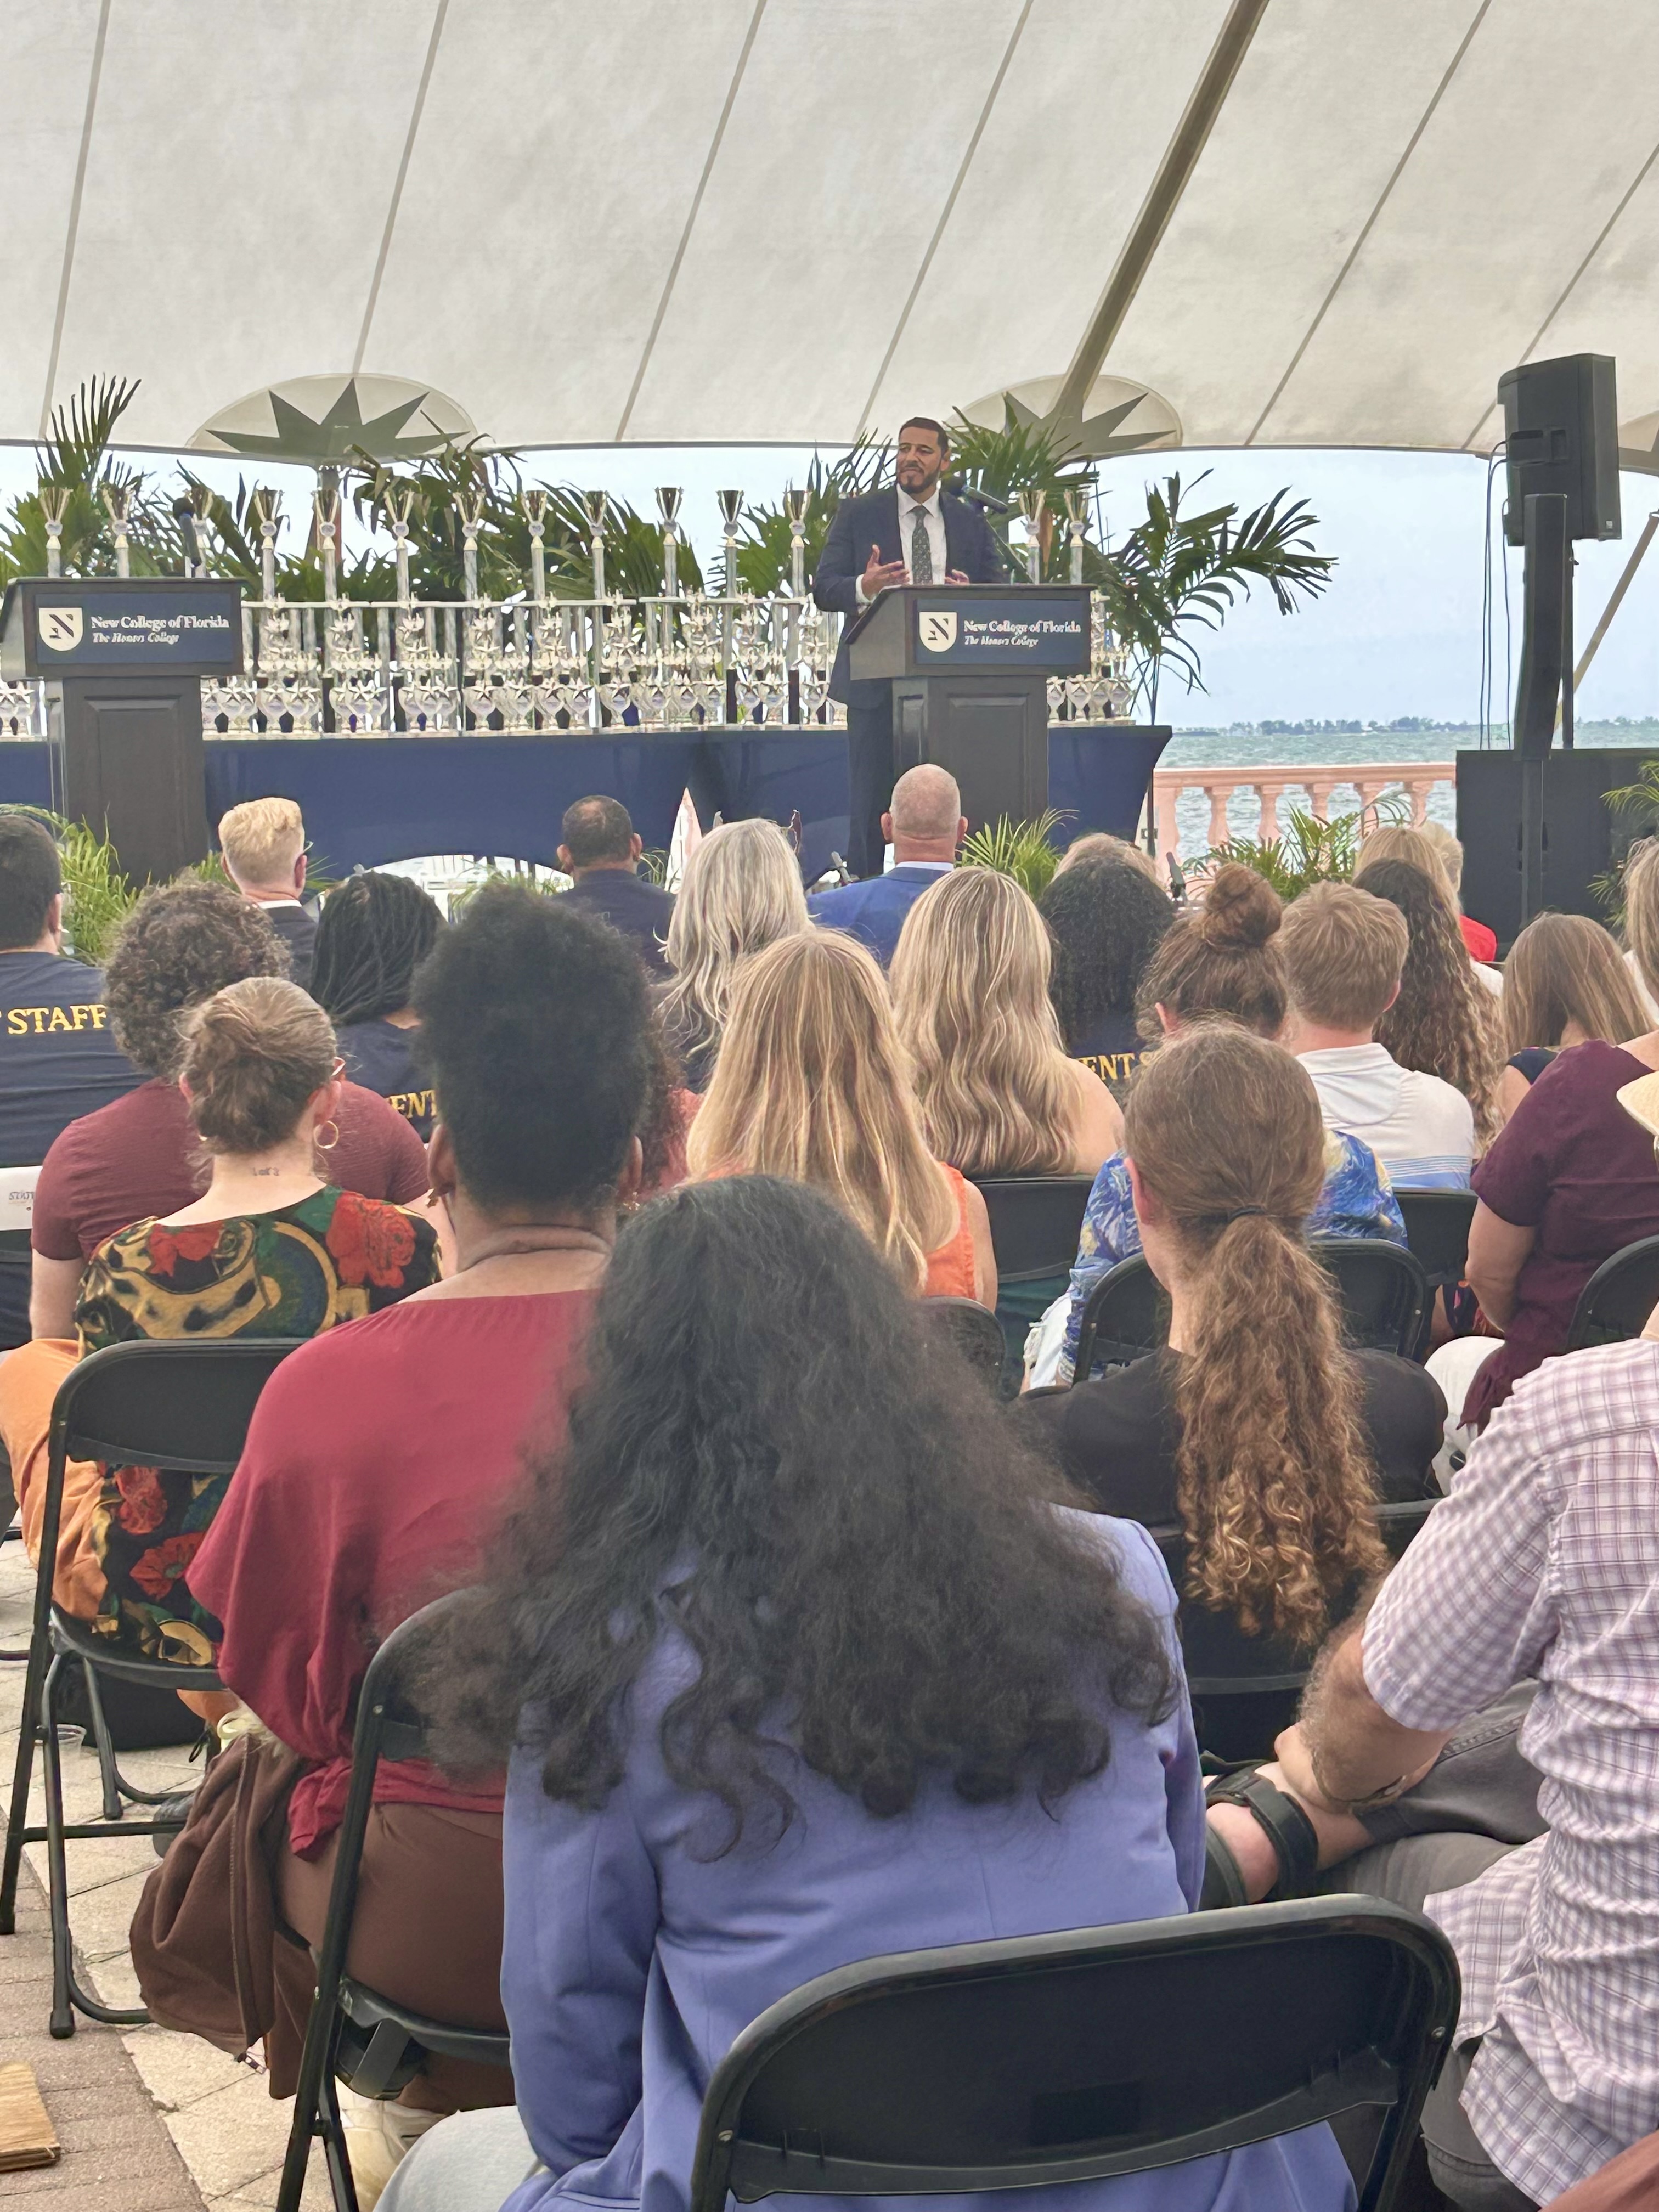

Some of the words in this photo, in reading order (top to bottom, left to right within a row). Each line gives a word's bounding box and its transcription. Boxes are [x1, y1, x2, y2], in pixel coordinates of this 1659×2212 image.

[91, 616, 119, 629] New
[121, 615, 166, 631] College
[168, 615, 184, 628] of
[184, 615, 229, 628] Florida
[963, 620, 986, 632] New
[989, 620, 1027, 636] College
[1029, 620, 1042, 632] of
[1042, 620, 1081, 633] Florida
[93, 632, 110, 644] The
[111, 633, 145, 644] Honors
[147, 631, 180, 645] College
[964, 635, 978, 645] The
[980, 635, 1009, 646] Honors
[1011, 635, 1039, 648] College
[8, 1003, 107, 1035] STAFF
